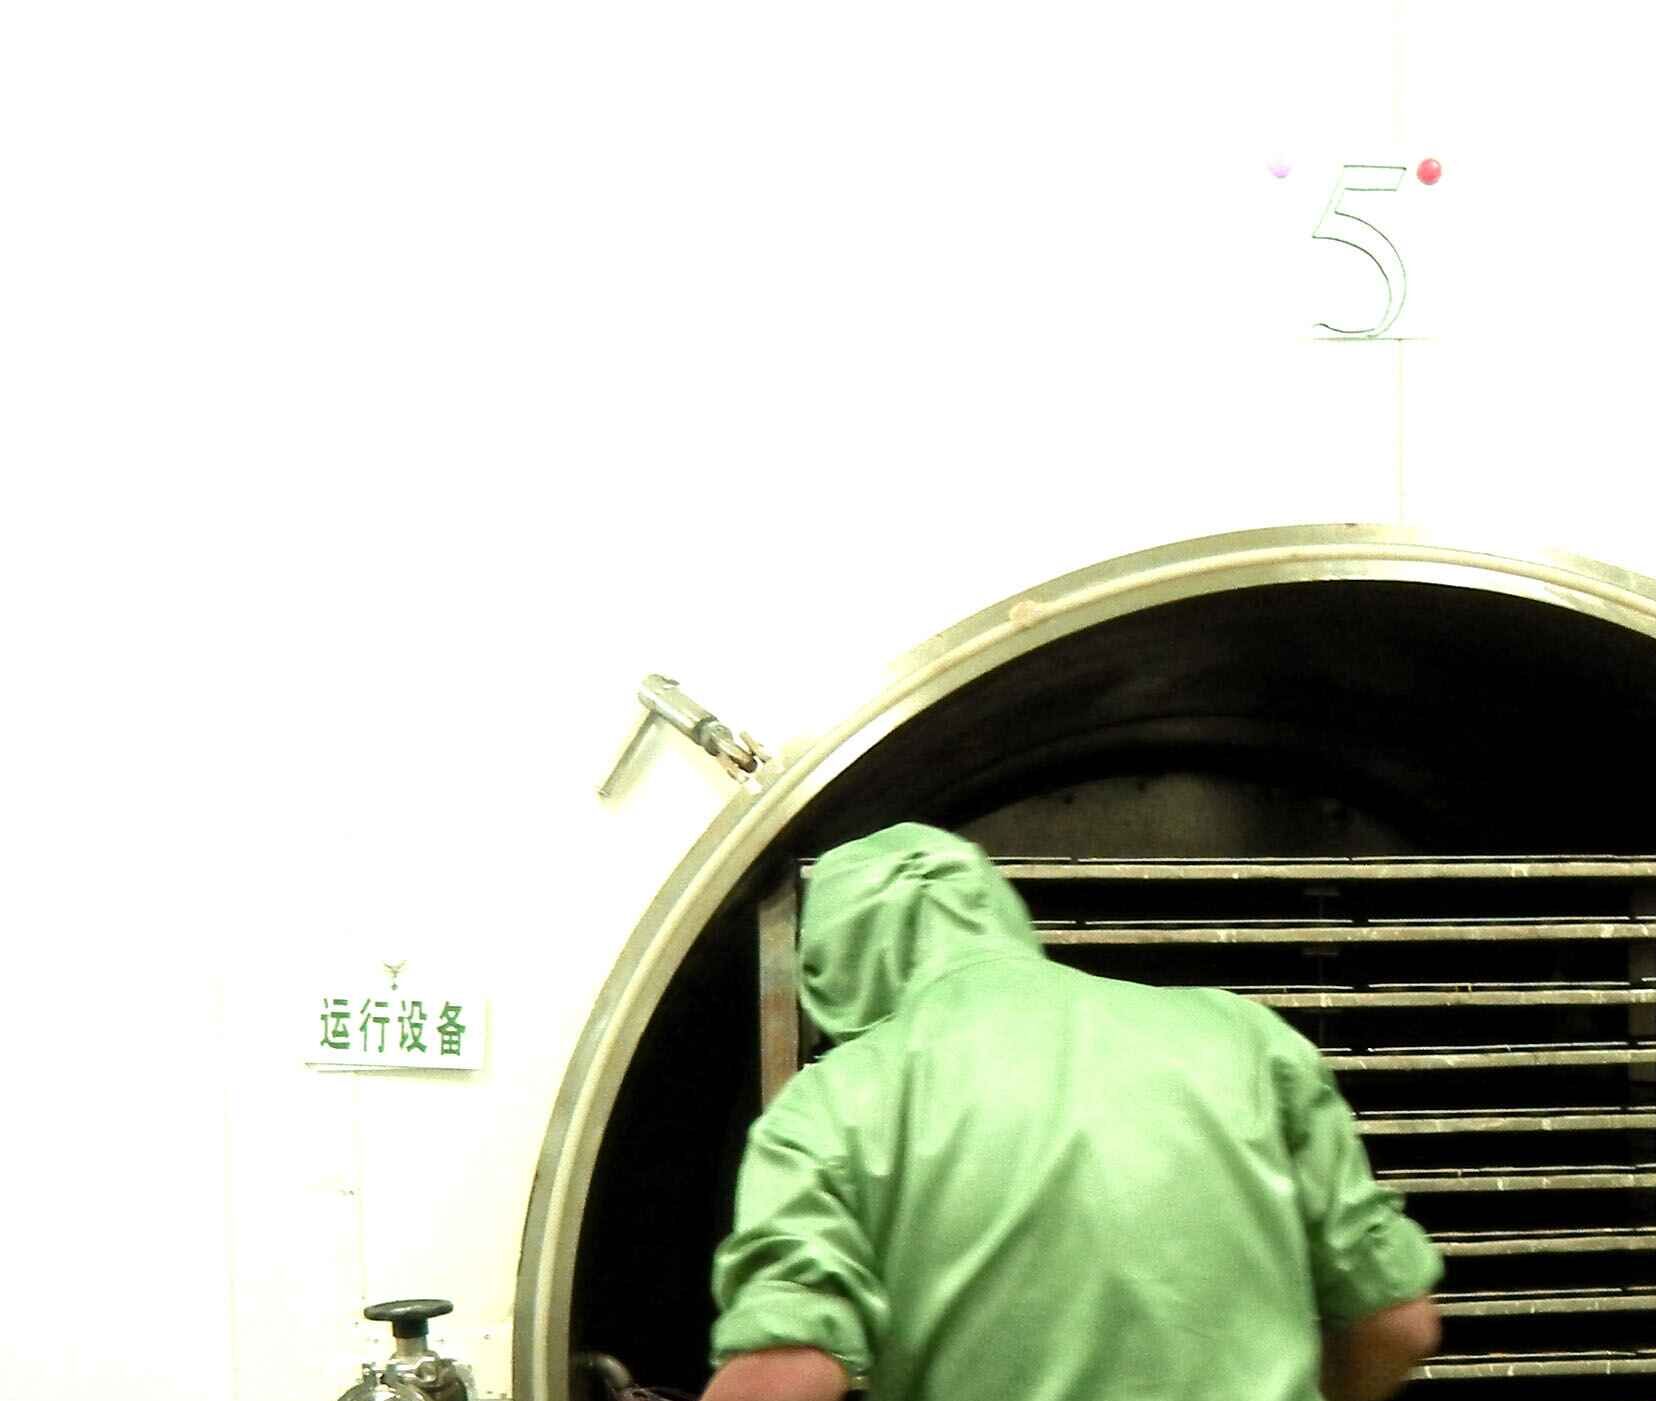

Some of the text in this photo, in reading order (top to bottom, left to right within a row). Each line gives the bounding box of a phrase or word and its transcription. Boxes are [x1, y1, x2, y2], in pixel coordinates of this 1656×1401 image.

[1312, 164, 1407, 339] 5
[320, 998, 466, 1056] 运行设备
